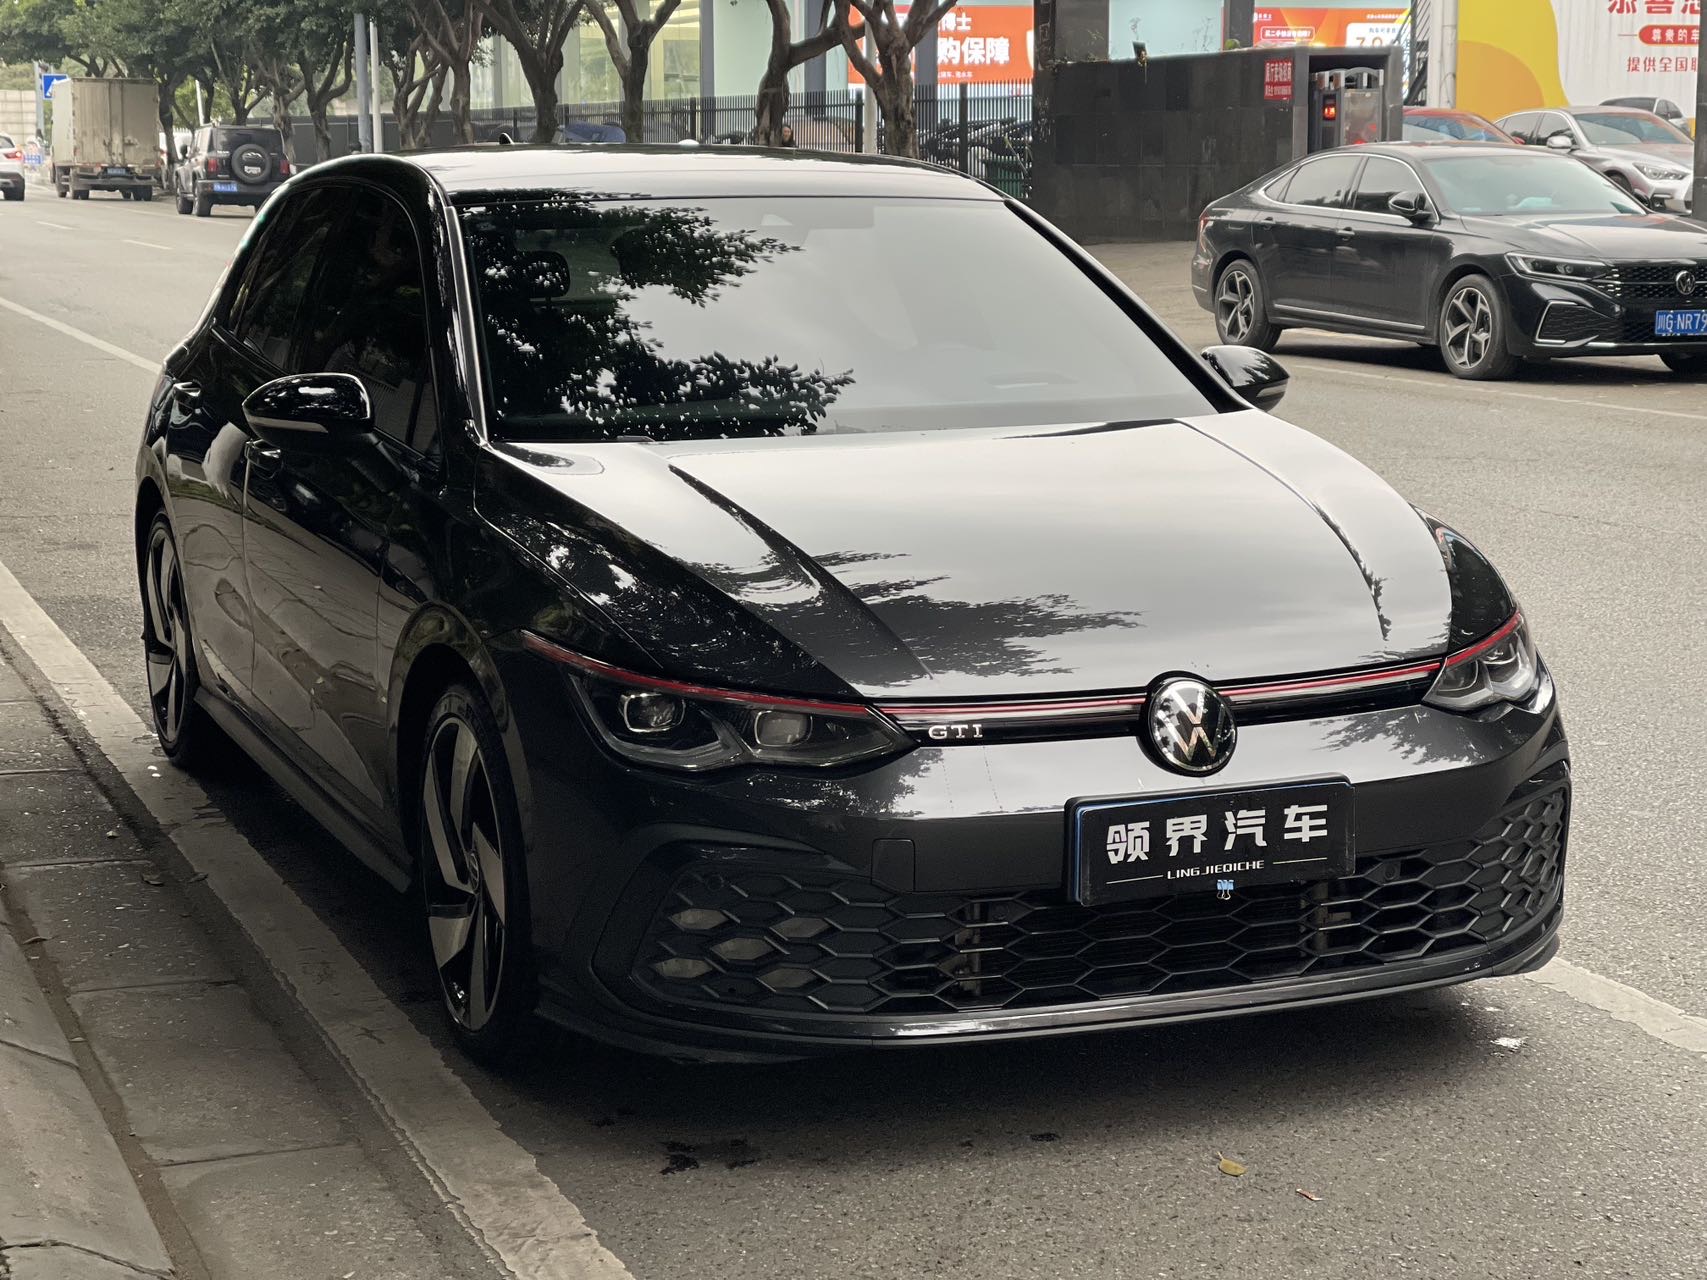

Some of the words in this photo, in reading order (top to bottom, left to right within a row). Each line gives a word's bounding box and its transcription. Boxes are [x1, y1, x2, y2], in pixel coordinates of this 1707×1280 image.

[937, 12, 973, 31] 博士
[929, 724, 983, 740] GTI
[1106, 804, 1328, 864] 领界汽车
